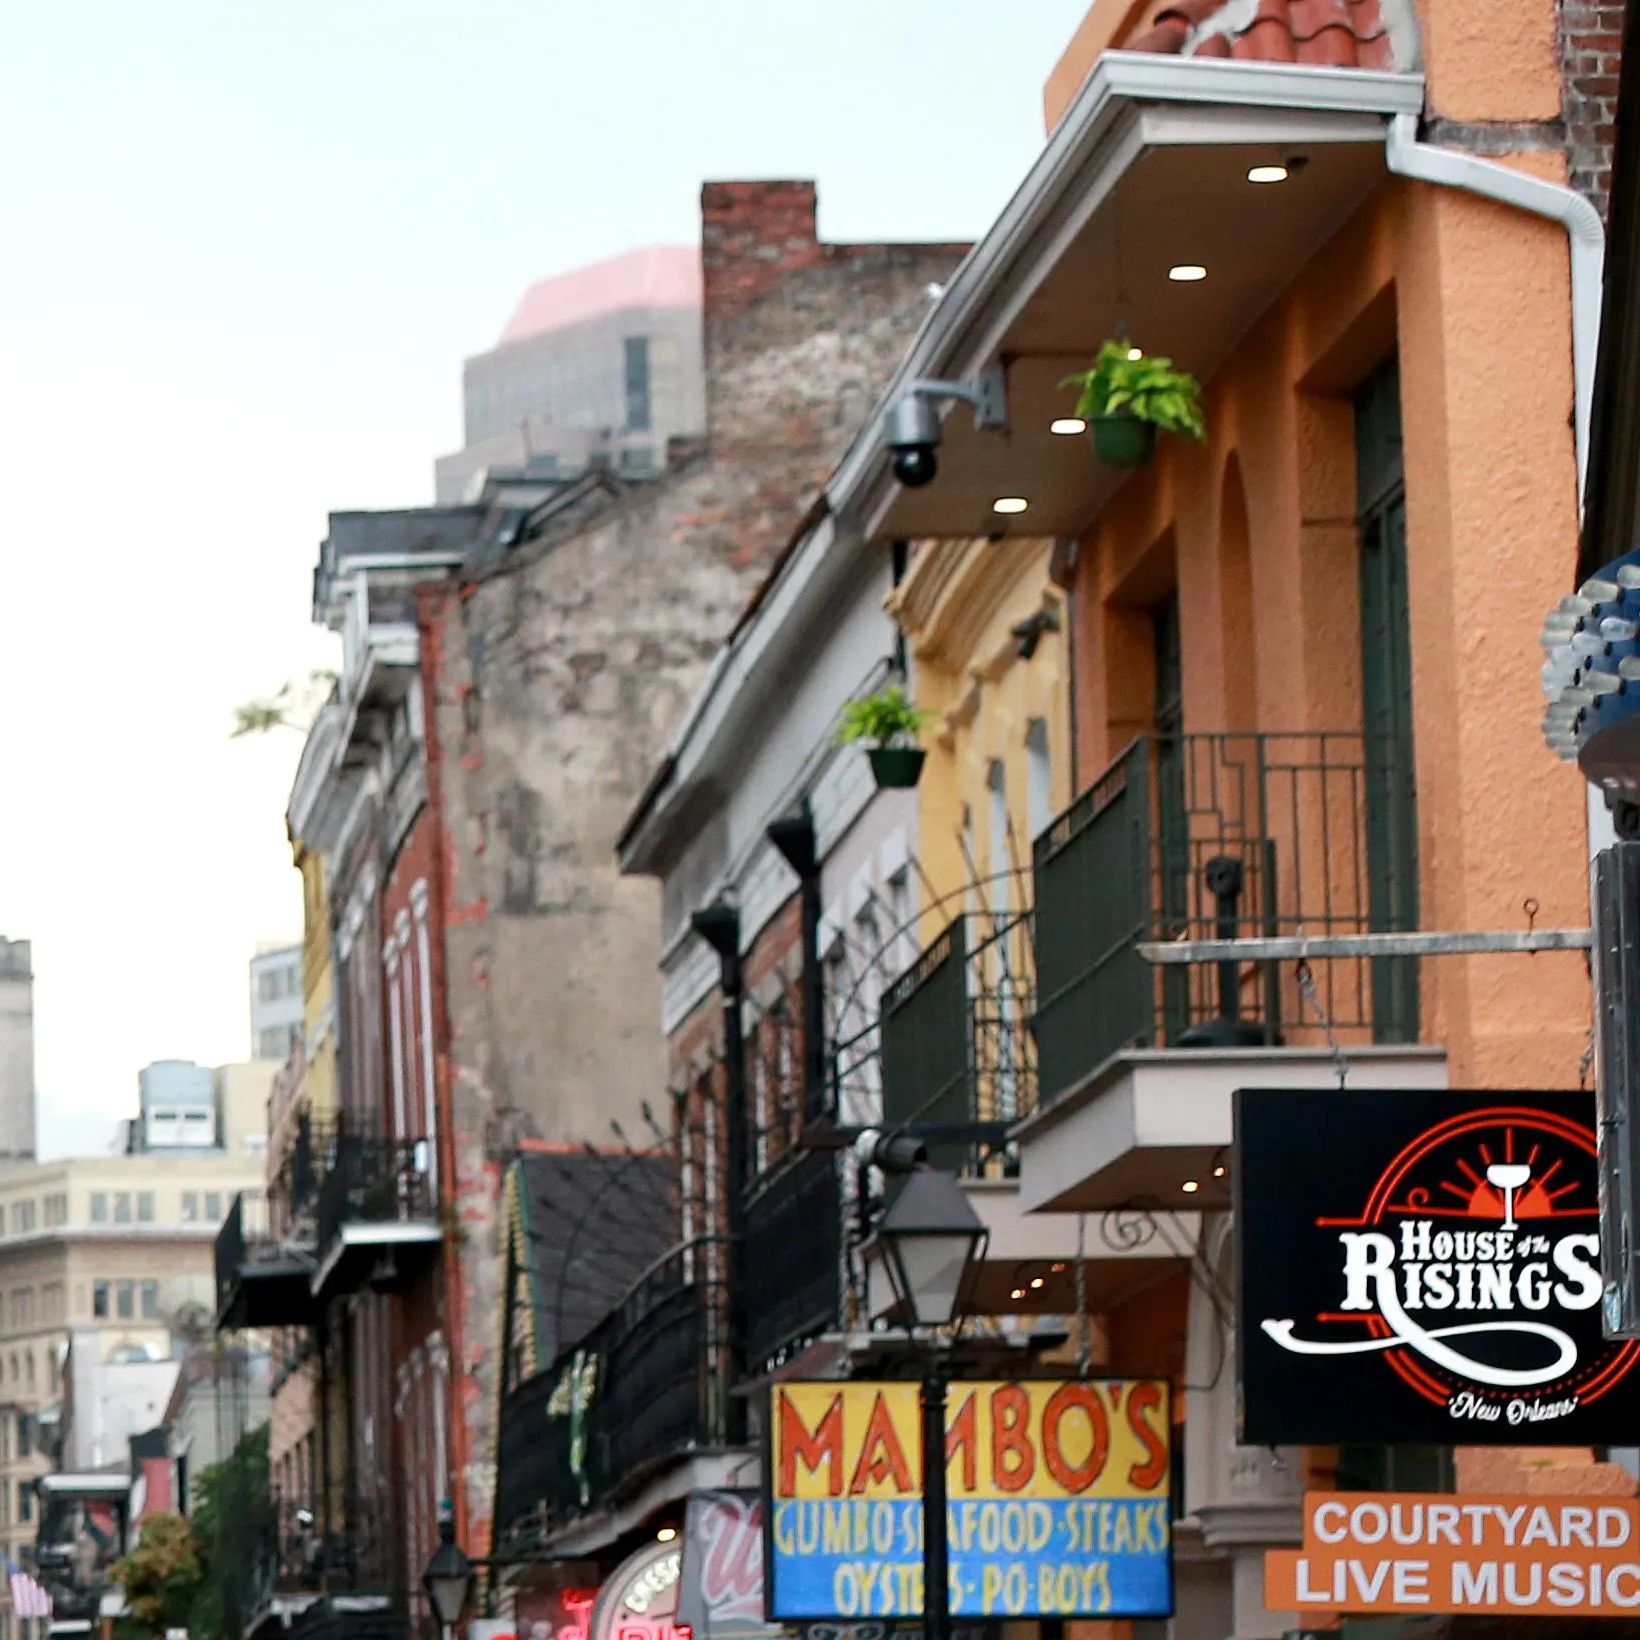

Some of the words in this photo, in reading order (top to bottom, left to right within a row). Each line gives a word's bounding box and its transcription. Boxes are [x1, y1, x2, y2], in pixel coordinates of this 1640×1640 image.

[1399, 1220, 1514, 1262] HOUSE
[1451, 1392, 1501, 1420] New
[1507, 1395, 1579, 1426] Orleans
[779, 1383, 1168, 1497] MAMBO'S
[1313, 1502, 1630, 1548] COURTYARD
[835, 1563, 965, 1614] OYSTES
[1296, 1559, 1430, 1604] LIVE
[1452, 1561, 1640, 1608] MUSIC
